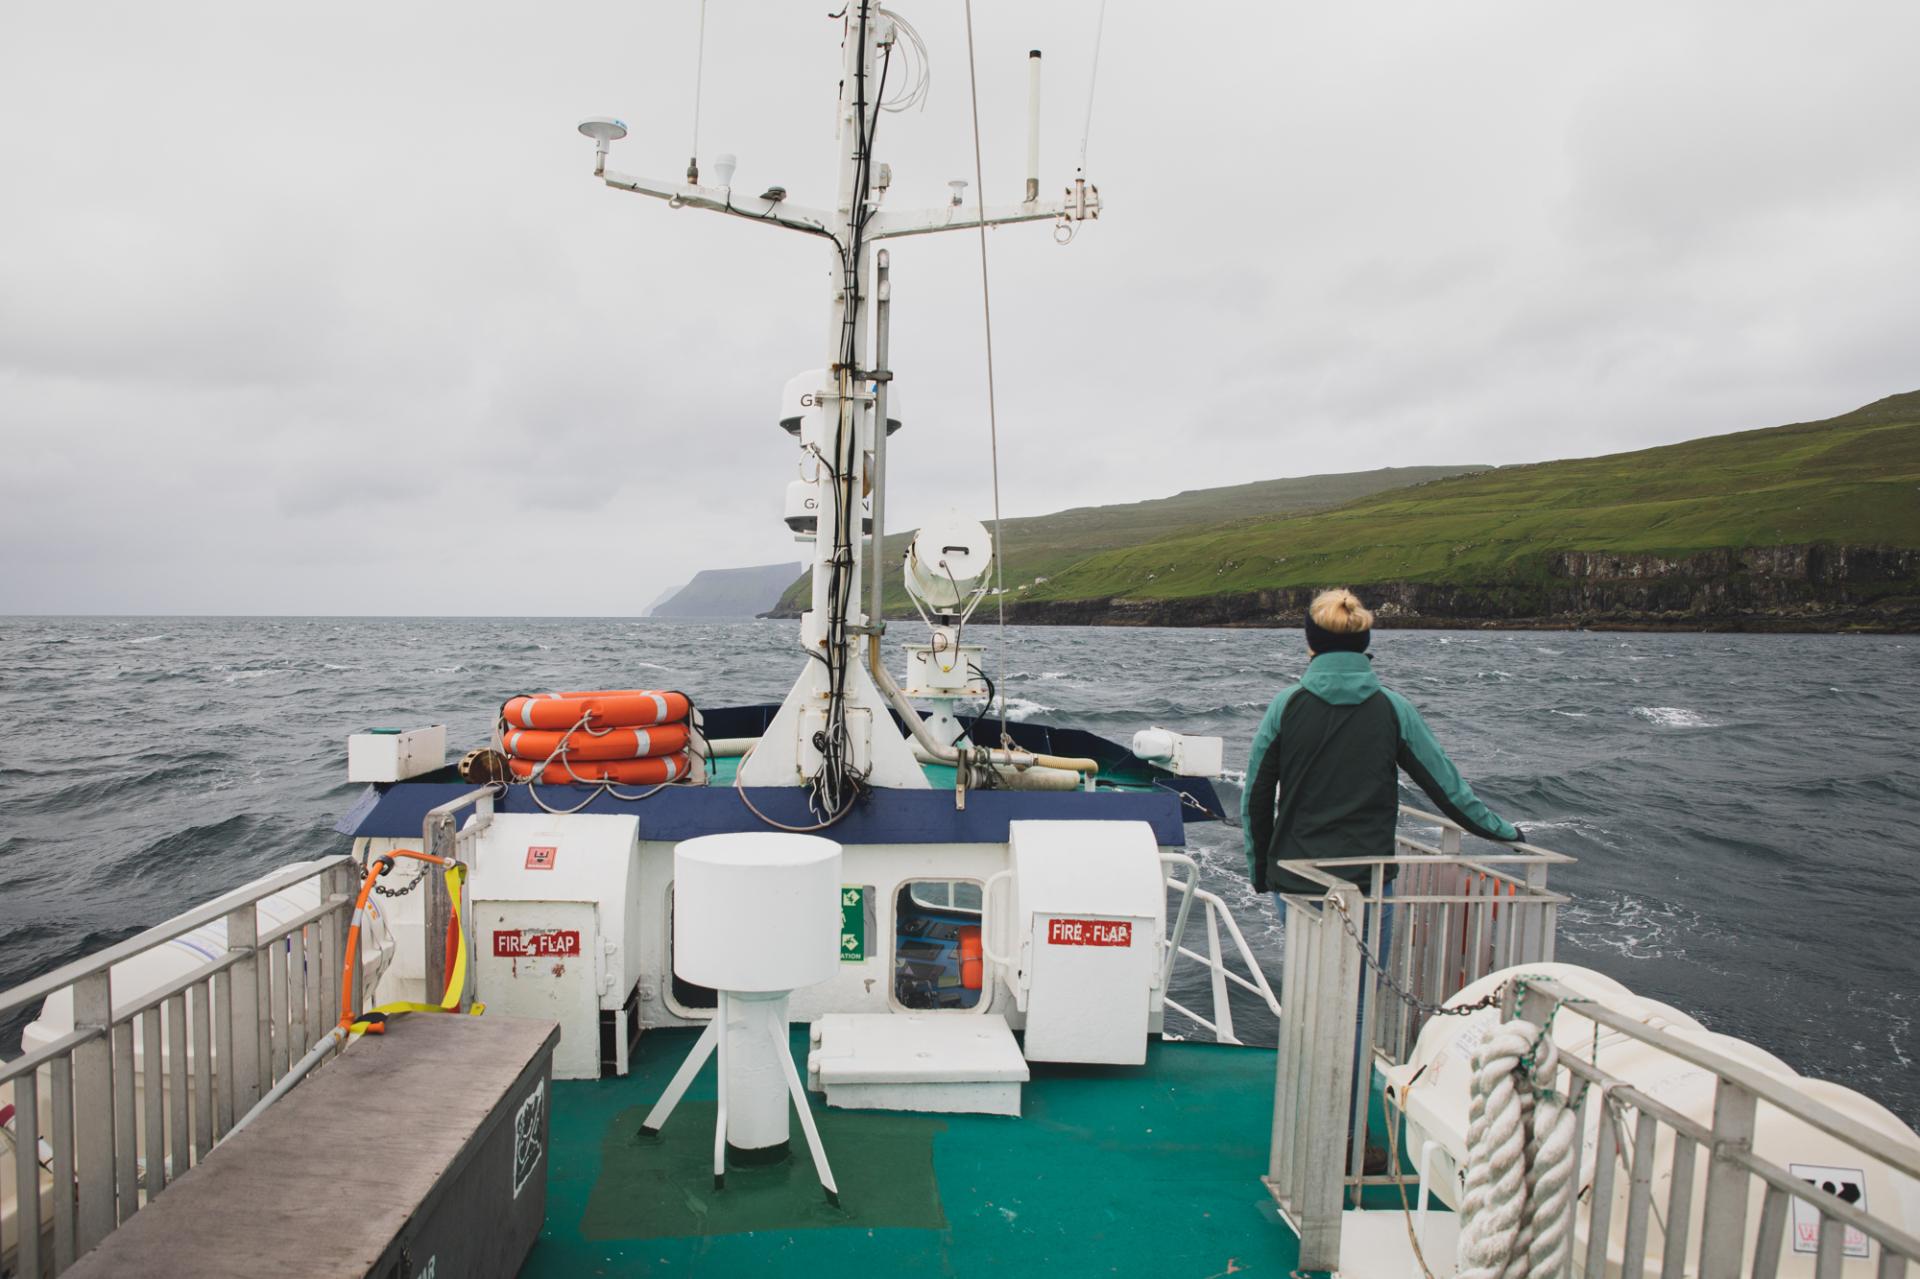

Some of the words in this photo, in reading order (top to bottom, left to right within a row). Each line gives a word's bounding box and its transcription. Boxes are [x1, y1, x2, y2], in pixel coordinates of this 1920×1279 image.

[1052, 923, 1082, 941] FIRE
[1093, 925, 1127, 942] FLAP
[540, 935, 575, 953] FLAP
[840, 952, 862, 960] ATION
